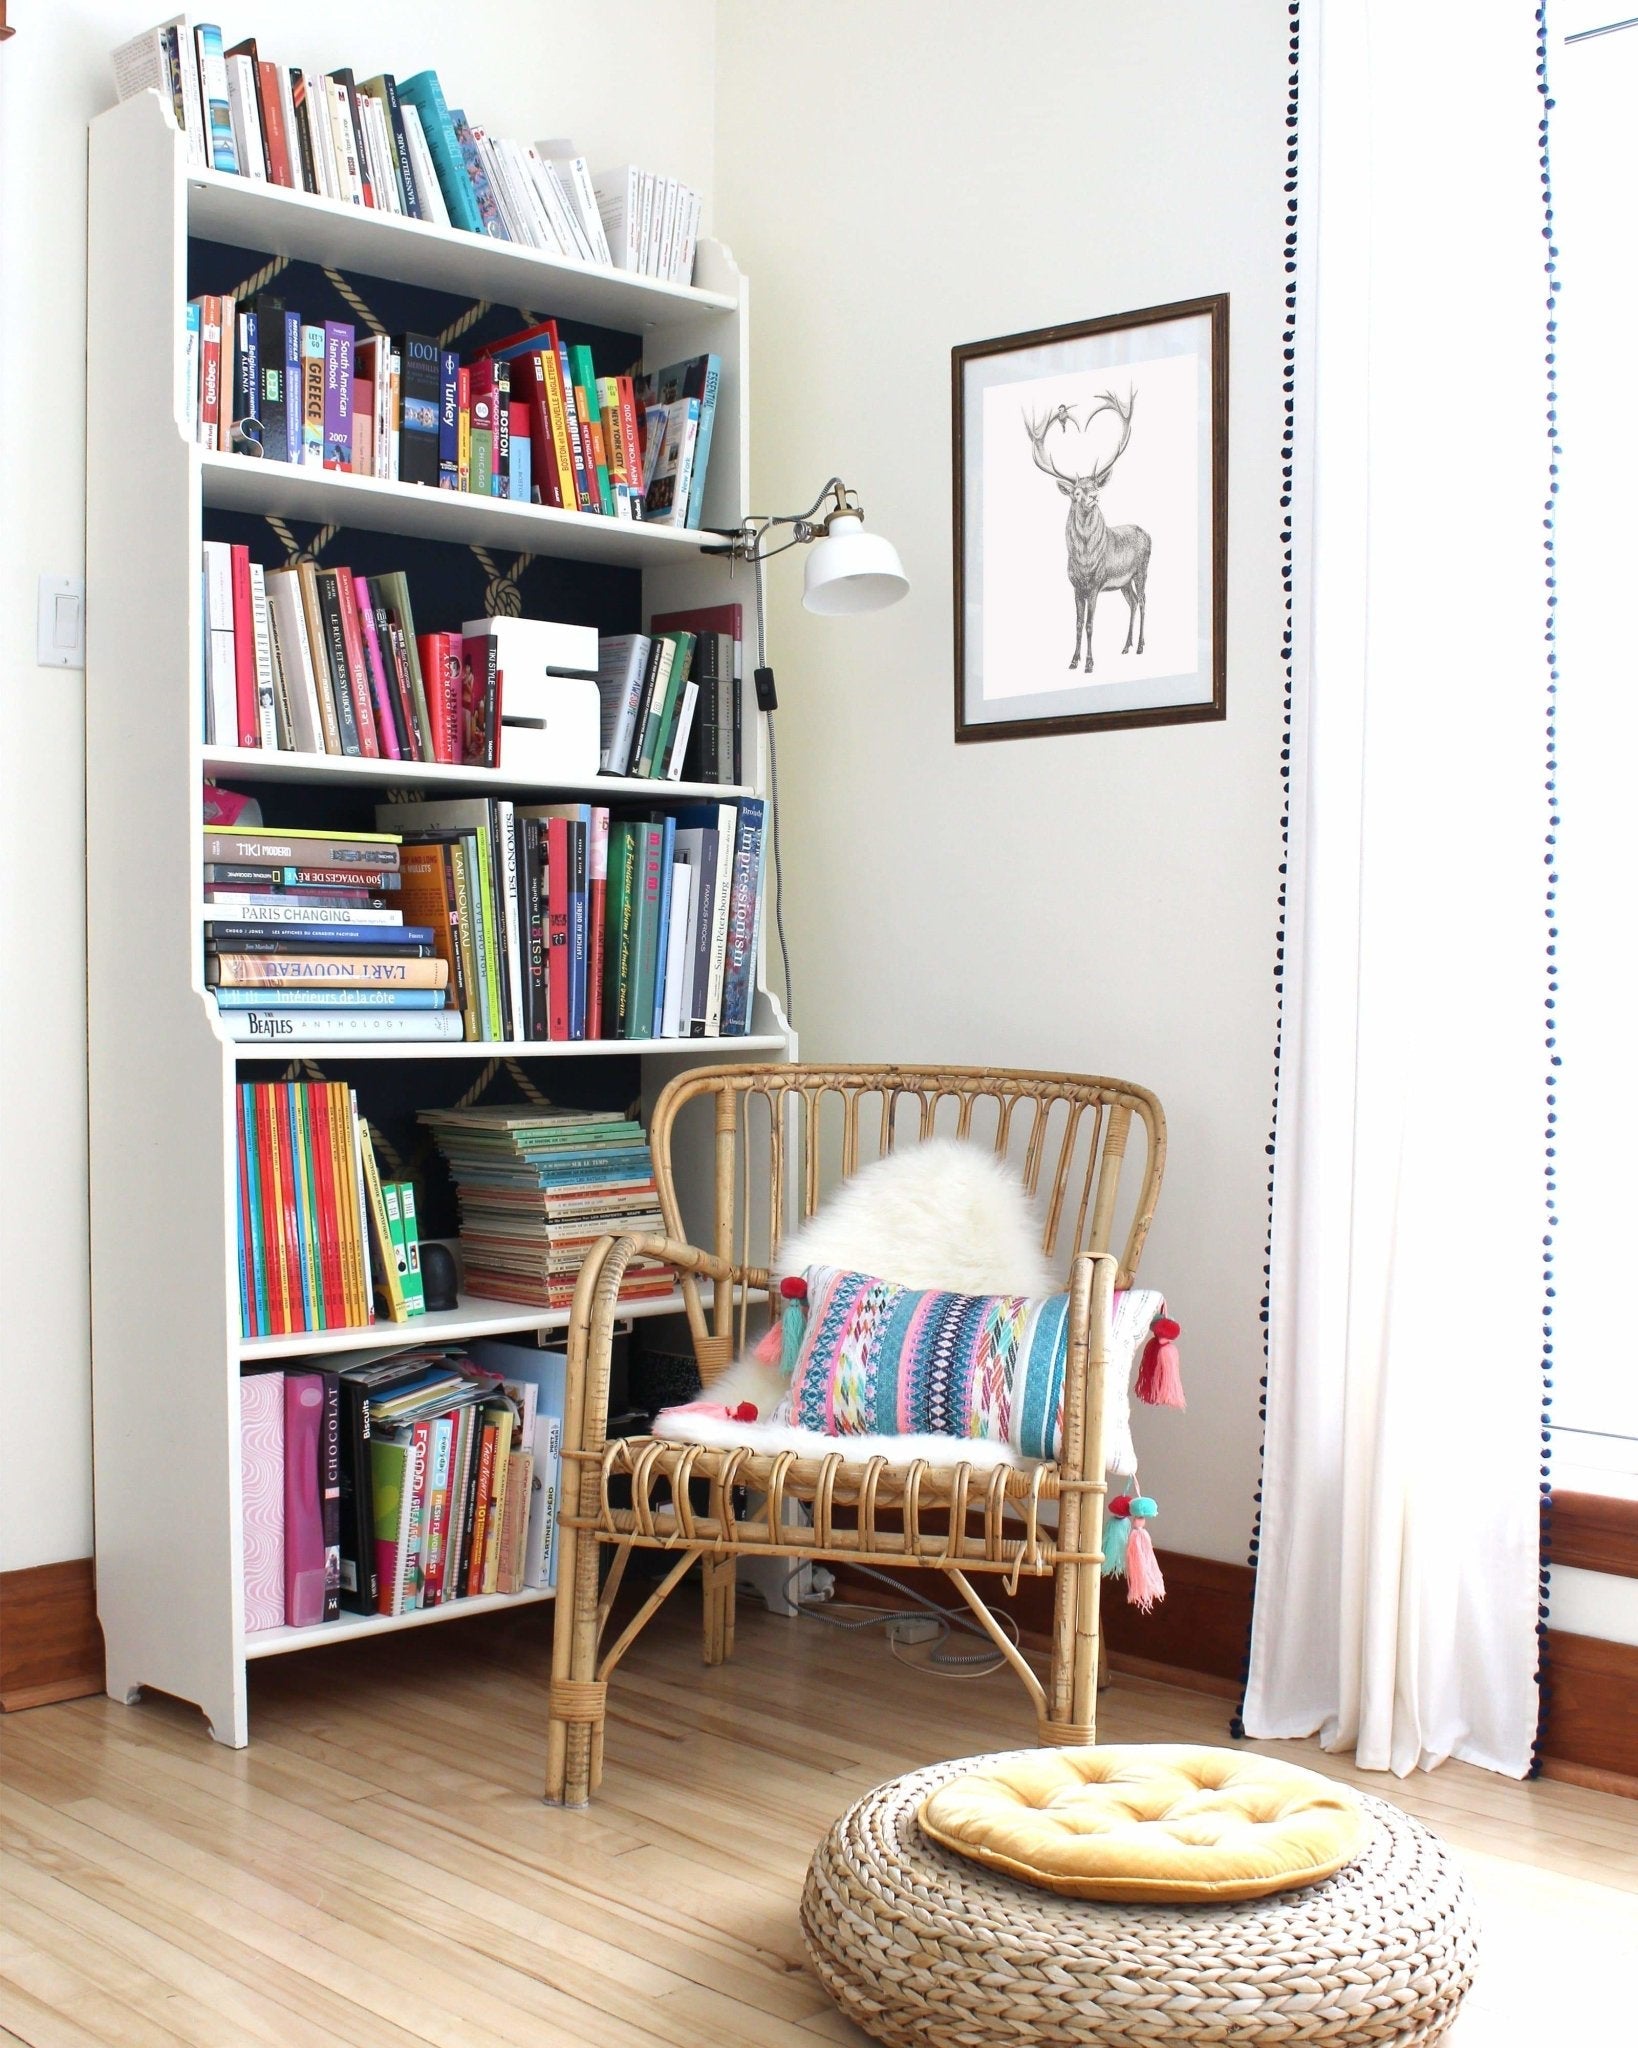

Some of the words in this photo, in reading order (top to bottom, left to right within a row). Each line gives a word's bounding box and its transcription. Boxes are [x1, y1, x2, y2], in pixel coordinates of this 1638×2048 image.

[396, 132, 406, 156] PARK
[401, 156, 415, 205] MANSFIELD
[309, 333, 323, 343] LET'S
[409, 342, 438, 362] 1001
[247, 344, 257, 377] Belgium
[328, 338, 339, 389] Handbook
[339, 339, 349, 368] South
[205, 359, 216, 405] Québec
[240, 355, 248, 393] ALBANIA
[544, 354, 558, 394] ANGLETERRE
[307, 362, 321, 418] GREECE
[337, 370, 349, 417] American
[442, 381, 456, 426] Turkey
[550, 394, 563, 431] NOUVELLE
[610, 408, 619, 427] NEW
[329, 432, 347, 444] 2007
[499, 410, 508, 456] BOSTON
[612, 428, 622, 449] YORK
[477, 446, 485, 487] CHICAGO
[557, 444, 569, 471] BOSTON
[574, 454, 584, 470] GO
[583, 439, 593, 469] ENGLAND
[615, 451, 624, 469] CITY
[681, 475, 689, 493] New
[330, 613, 338, 624] LE
[267, 599, 280, 644] Communication
[274, 651, 288, 698] épanouissement
[281, 698, 292, 728] personnel
[335, 650, 342, 662] ET
[488, 648, 496, 661] TIKI
[336, 663, 345, 678] SES
[352, 663, 368, 707] Japonais
[442, 652, 452, 709] D'ORSAY
[487, 662, 496, 684] STYLE
[338, 679, 353, 724] SYMBOLES
[626, 680, 641, 716] AWESOME
[360, 708, 370, 724] Les
[236, 843, 260, 856] TIKI
[262, 846, 291, 857] MODERN
[505, 812, 515, 871] GNOMES
[312, 873, 323, 882] DE
[324, 874, 365, 884] VOYAGES
[366, 875, 381, 884] 500
[455, 851, 465, 880] L'ART
[646, 831, 660, 902] miami
[508, 875, 516, 898] LES
[702, 883, 710, 917] FAMOUS
[728, 823, 755, 968] Impressionism
[242, 907, 280, 920] PARIS
[284, 909, 351, 922] CHANGING
[458, 884, 471, 947] NOUVEAU
[713, 881, 729, 970] Saint-Pétersbourg
[528, 914, 543, 975] design
[699, 918, 708, 952] FROCKS
[266, 963, 353, 976] NOUVEAU
[362, 965, 405, 979] L'ART
[534, 978, 540, 986] Le
[277, 990, 335, 1003] Intérieurs
[339, 990, 352, 1003] de
[355, 990, 366, 1003] la
[369, 990, 395, 1004] côte
[248, 1013, 293, 1037] BEATLES
[302, 1020, 405, 1028] ANTHOLOGY
[362, 1129, 368, 1137] 5
[327, 1387, 339, 1480] CHOCOLAT
[363, 1399, 371, 1440] Biscuits
[437, 1436, 448, 1472] everyday
[522, 1459, 530, 1487] Cuisine
[433, 1494, 441, 1521] FRESH
[477, 1503, 486, 1522] 101
[545, 1486, 555, 1516] APÉRO
[430, 1522, 439, 1552] FLAVOR
[542, 1519, 553, 1559] TARTINES
[428, 1553, 436, 1574] FAST
